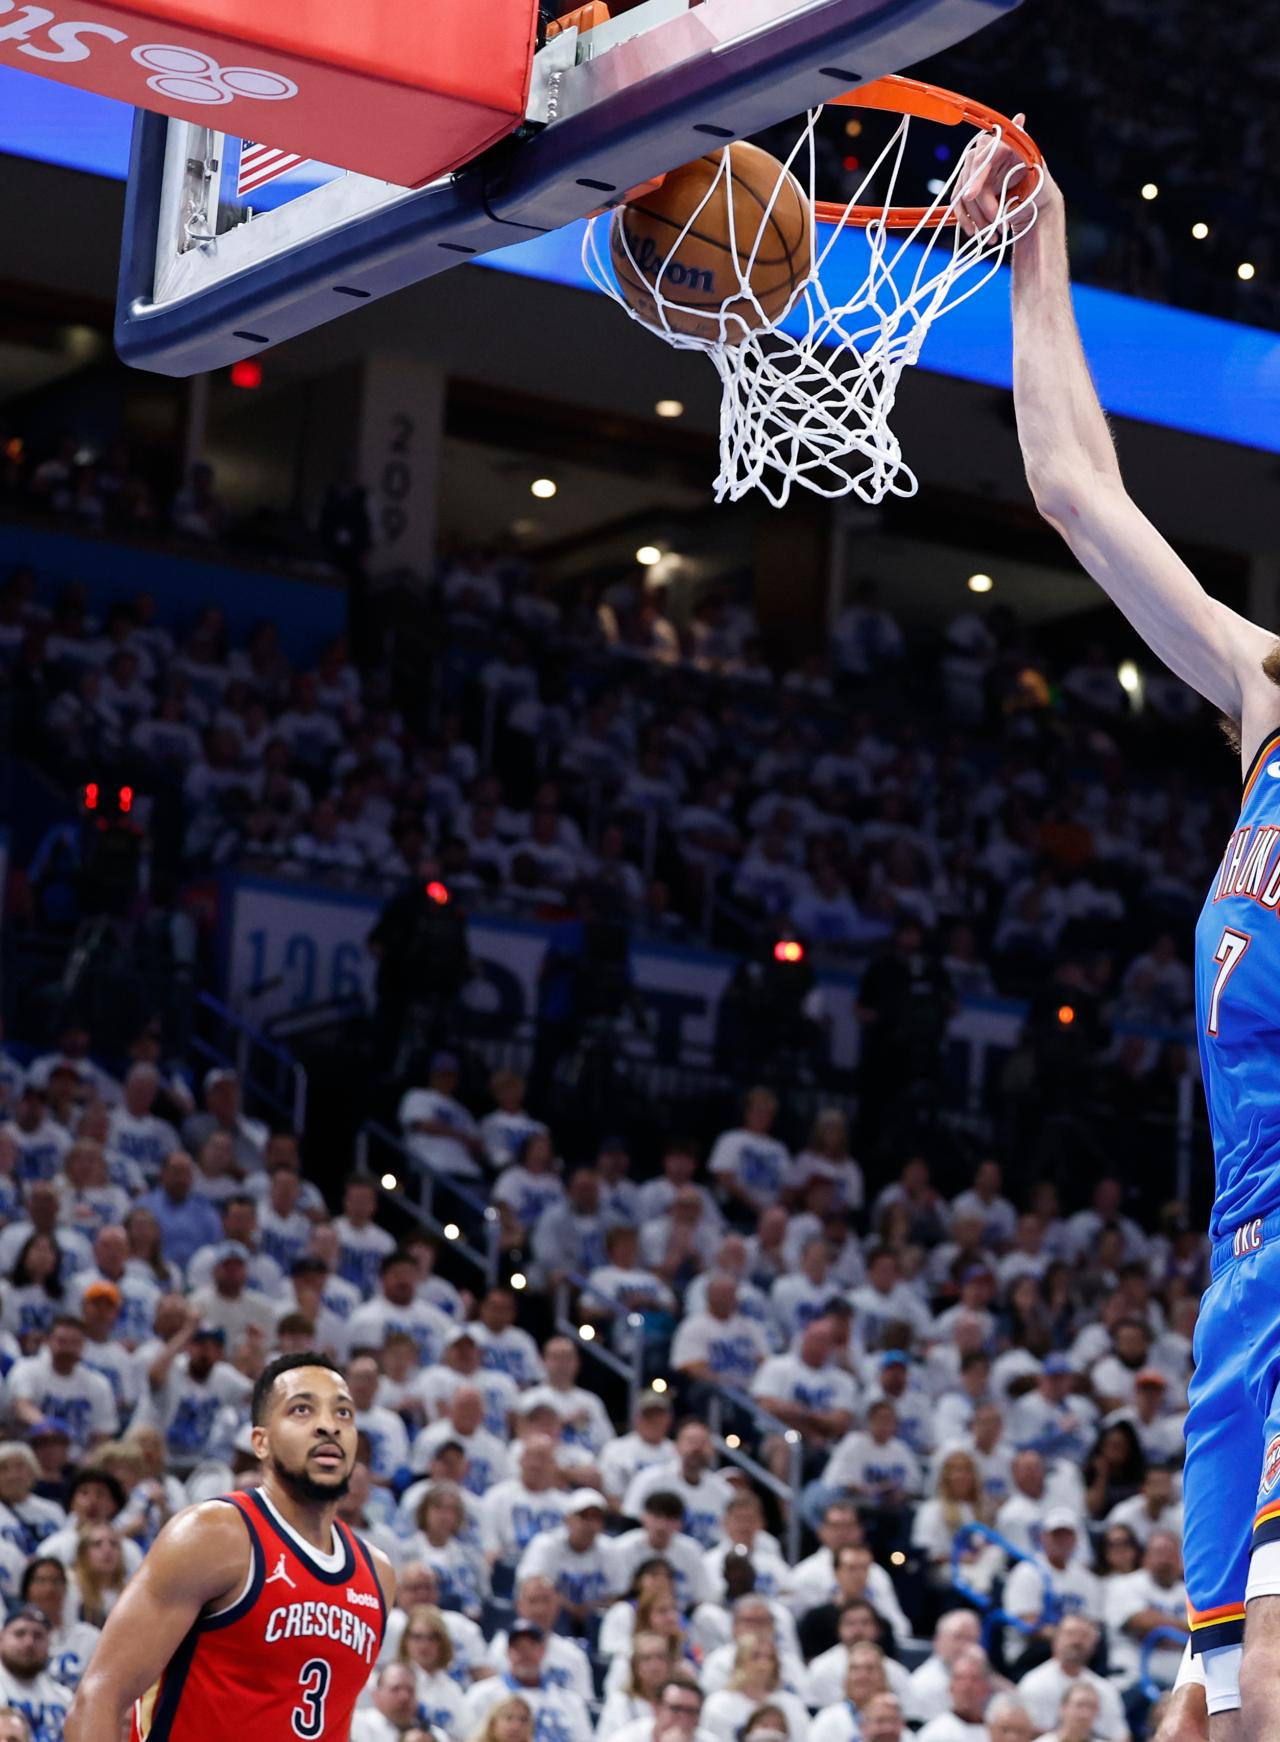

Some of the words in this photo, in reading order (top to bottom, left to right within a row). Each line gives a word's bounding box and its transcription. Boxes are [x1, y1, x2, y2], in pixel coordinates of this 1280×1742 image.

[1207, 925, 1252, 1038] 7
[1234, 1218, 1263, 1257] OKC
[265, 1602, 377, 1664] CRESCENT
[290, 1657, 332, 1741] 3
